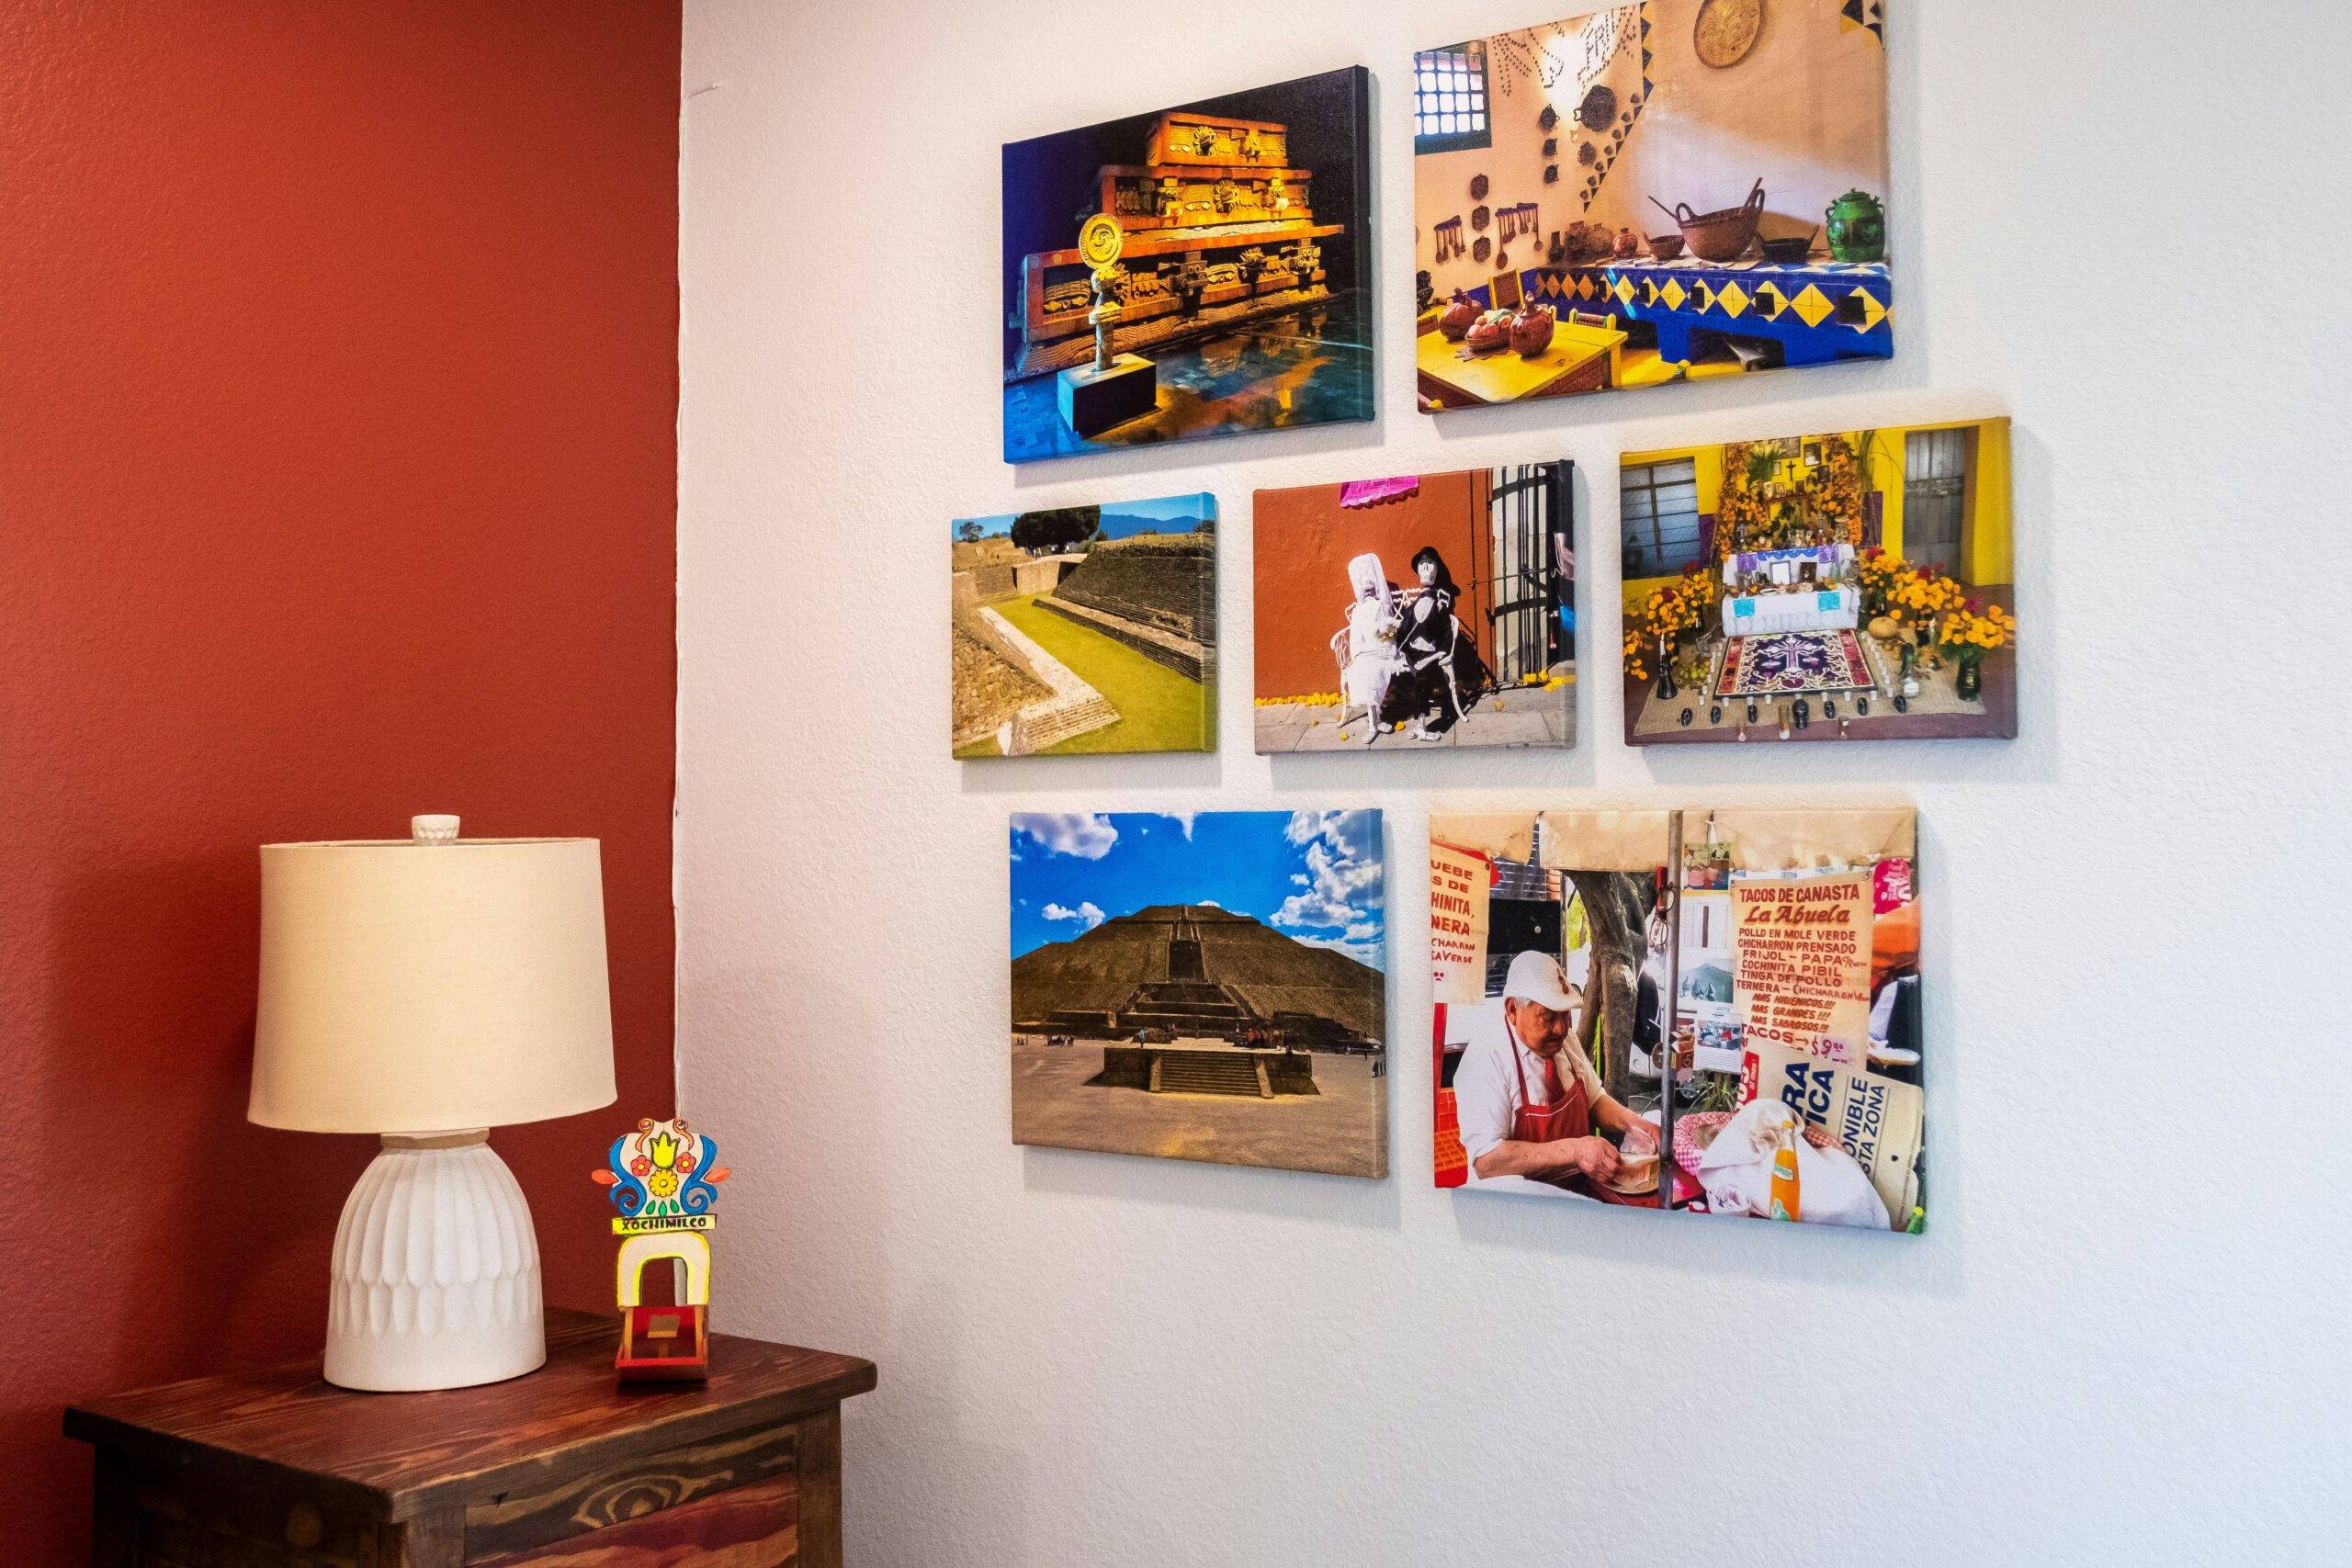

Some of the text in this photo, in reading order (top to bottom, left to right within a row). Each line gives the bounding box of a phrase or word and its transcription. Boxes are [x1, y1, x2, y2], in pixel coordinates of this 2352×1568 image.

[1431, 876, 1469, 893] S DE
[1740, 884, 1860, 902] TACOS DE CANASTA
[1744, 904, 1850, 924] La Abuela
[1431, 914, 1470, 935] NERA
[1738, 928, 1856, 941] POLLO EN MOLE VERDE
[1738, 939, 1856, 953] CHICHARRON PRENSADO
[1743, 950, 1786, 961] FRIJOL
[1802, 953, 1842, 964] PAPA
[1742, 960, 1842, 976] COCHINITA PIBIL
[1736, 979, 1781, 993] TERNERA
[1740, 970, 1842, 987] TINGA DE POLLO
[1752, 993, 1771, 1003] MAS
[1751, 1004, 1769, 1014] MAS
[1751, 1015, 1768, 1025] MAS
[1741, 1023, 1793, 1043] TACOS
[1781, 1062, 1810, 1118] RA
[1863, 1085, 1885, 1138] ZONA
[622, 1217, 707, 1230] XOCHIMILCO
